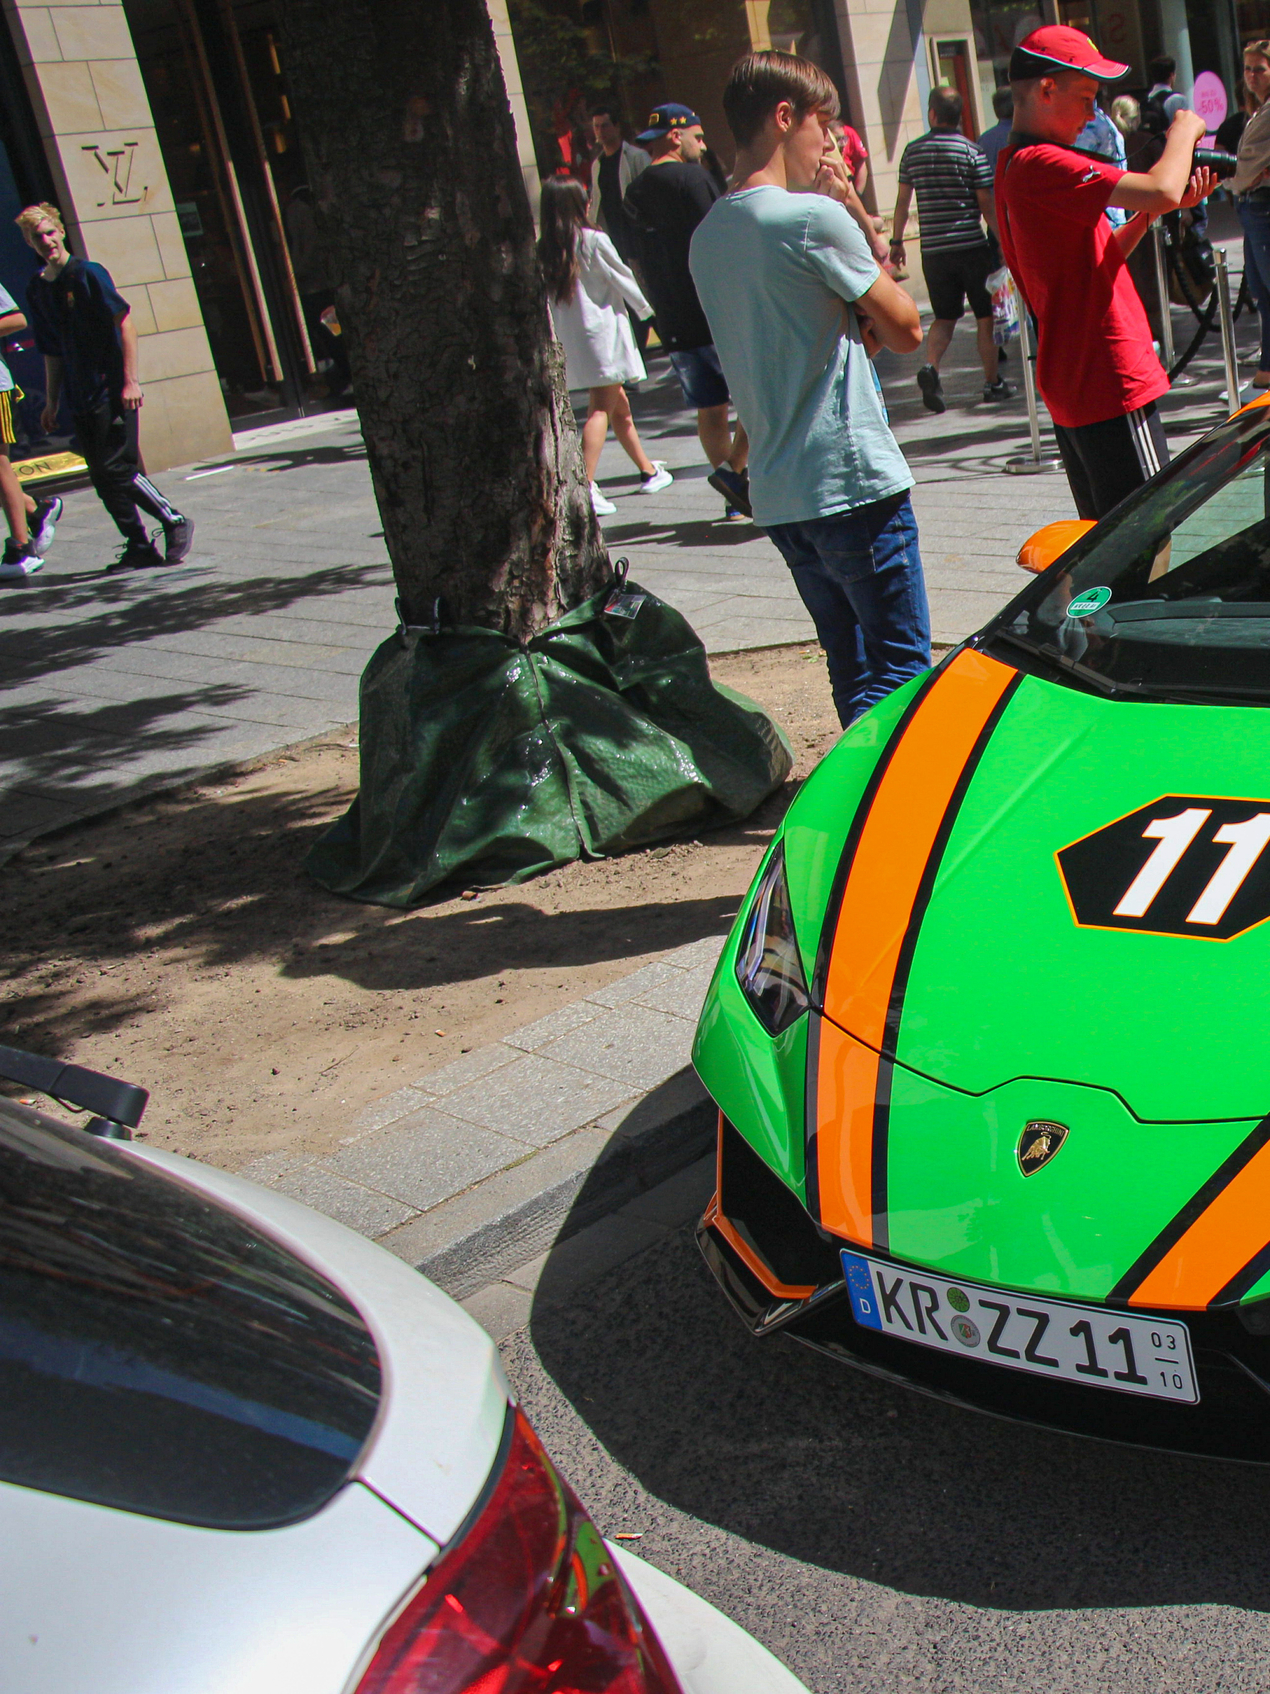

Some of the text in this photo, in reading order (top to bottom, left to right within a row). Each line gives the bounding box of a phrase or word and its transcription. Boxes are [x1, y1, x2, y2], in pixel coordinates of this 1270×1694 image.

[1197, 97, 1224, 114] -50%
[12, 461, 52, 477] ON
[1086, 588, 1103, 603] 4
[860, 1297, 871, 1314] D
[876, 1270, 949, 1342] KR
[1151, 1331, 1176, 1350] 03
[1160, 1371, 1184, 1390] 10
